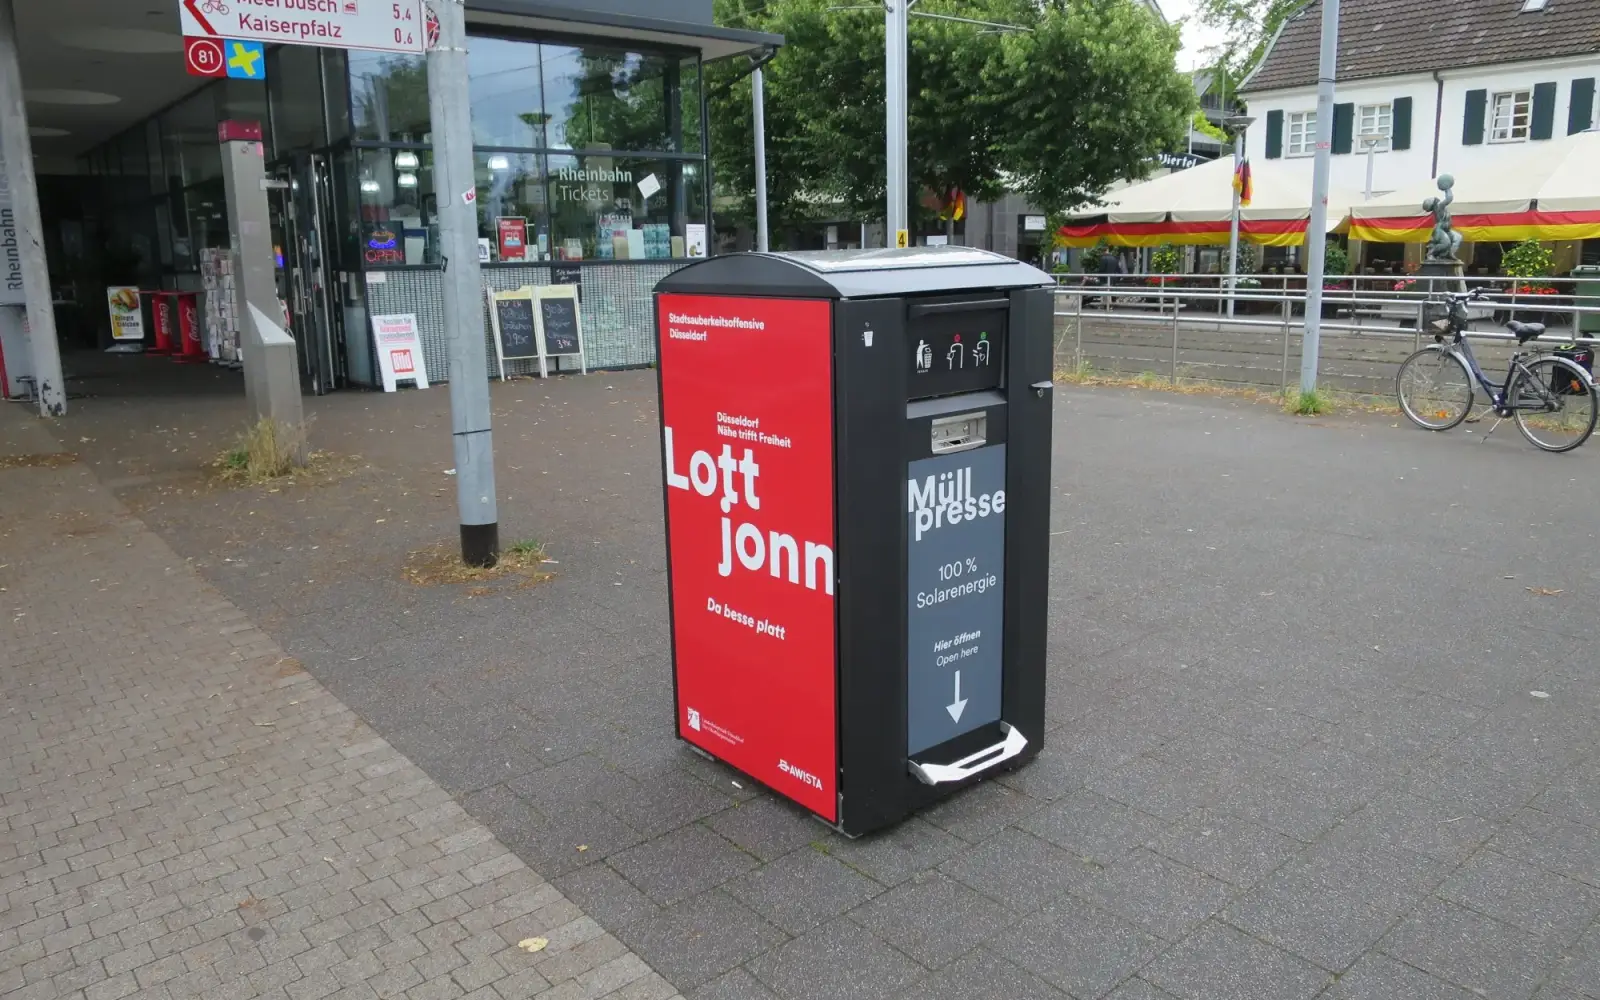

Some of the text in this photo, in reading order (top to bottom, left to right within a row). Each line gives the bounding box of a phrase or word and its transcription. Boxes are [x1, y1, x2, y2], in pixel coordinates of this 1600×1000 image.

[238, 12, 342, 39] Kaiserpfalz
[198, 50, 215, 64] 81
[559, 164, 633, 182] Rheinbahn
[559, 185, 609, 202] Tickets
[0, 208, 23, 291] Rheinbahn
[898, 232, 906, 248] 4
[365, 249, 403, 263] OPEN
[669, 312, 765, 330] Stadtsauberkeitsoffensive
[669, 328, 707, 342] Düsseldorf
[716, 411, 759, 429] Düsseldorf
[717, 425, 792, 449] Nähe trifft Freiheit
[664, 426, 761, 511] Lott
[908, 466, 972, 513] Müll
[915, 490, 1006, 542] presse
[718, 496, 834, 596] jonn
[938, 557, 978, 582] 100 %
[916, 572, 997, 609] Solarenergie
[707, 597, 786, 641] Da besse platt
[933, 630, 981, 653] Hier öffnen
[936, 645, 979, 667] Open here
[789, 764, 823, 791] AWISTA
